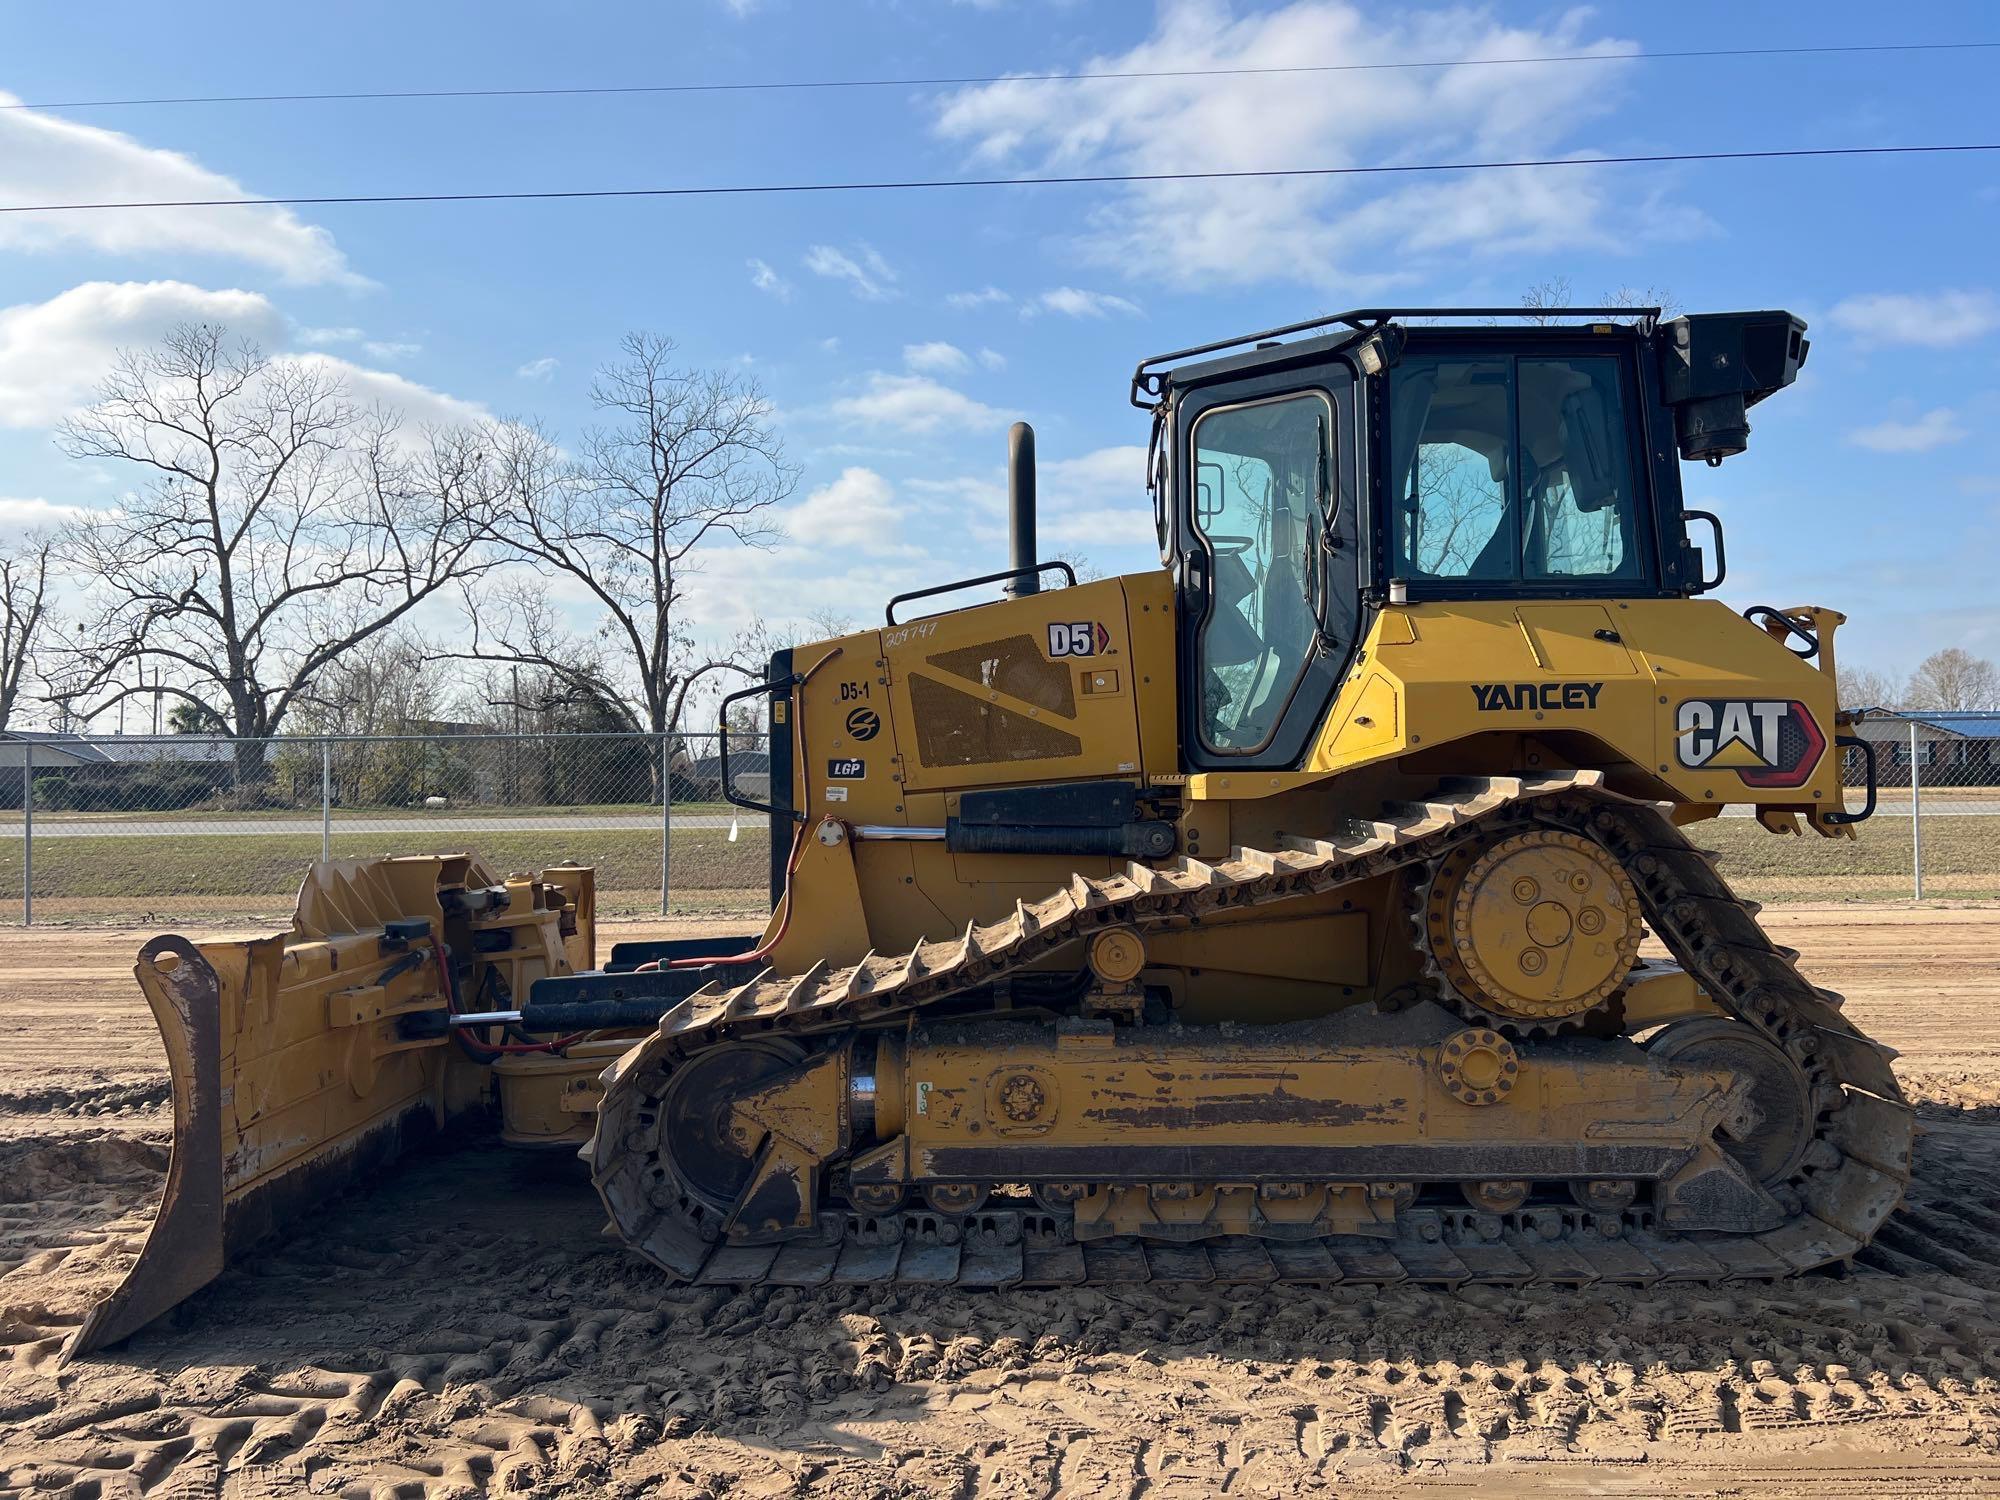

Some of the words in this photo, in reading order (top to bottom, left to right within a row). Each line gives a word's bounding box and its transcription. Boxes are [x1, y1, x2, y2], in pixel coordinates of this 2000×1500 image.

[1049, 624, 1090, 655] D5
[840, 681, 870, 700] D5-1
[1470, 683, 1604, 711] YANCEY
[1678, 701, 1788, 767] CAT
[834, 762, 860, 775] LGP
